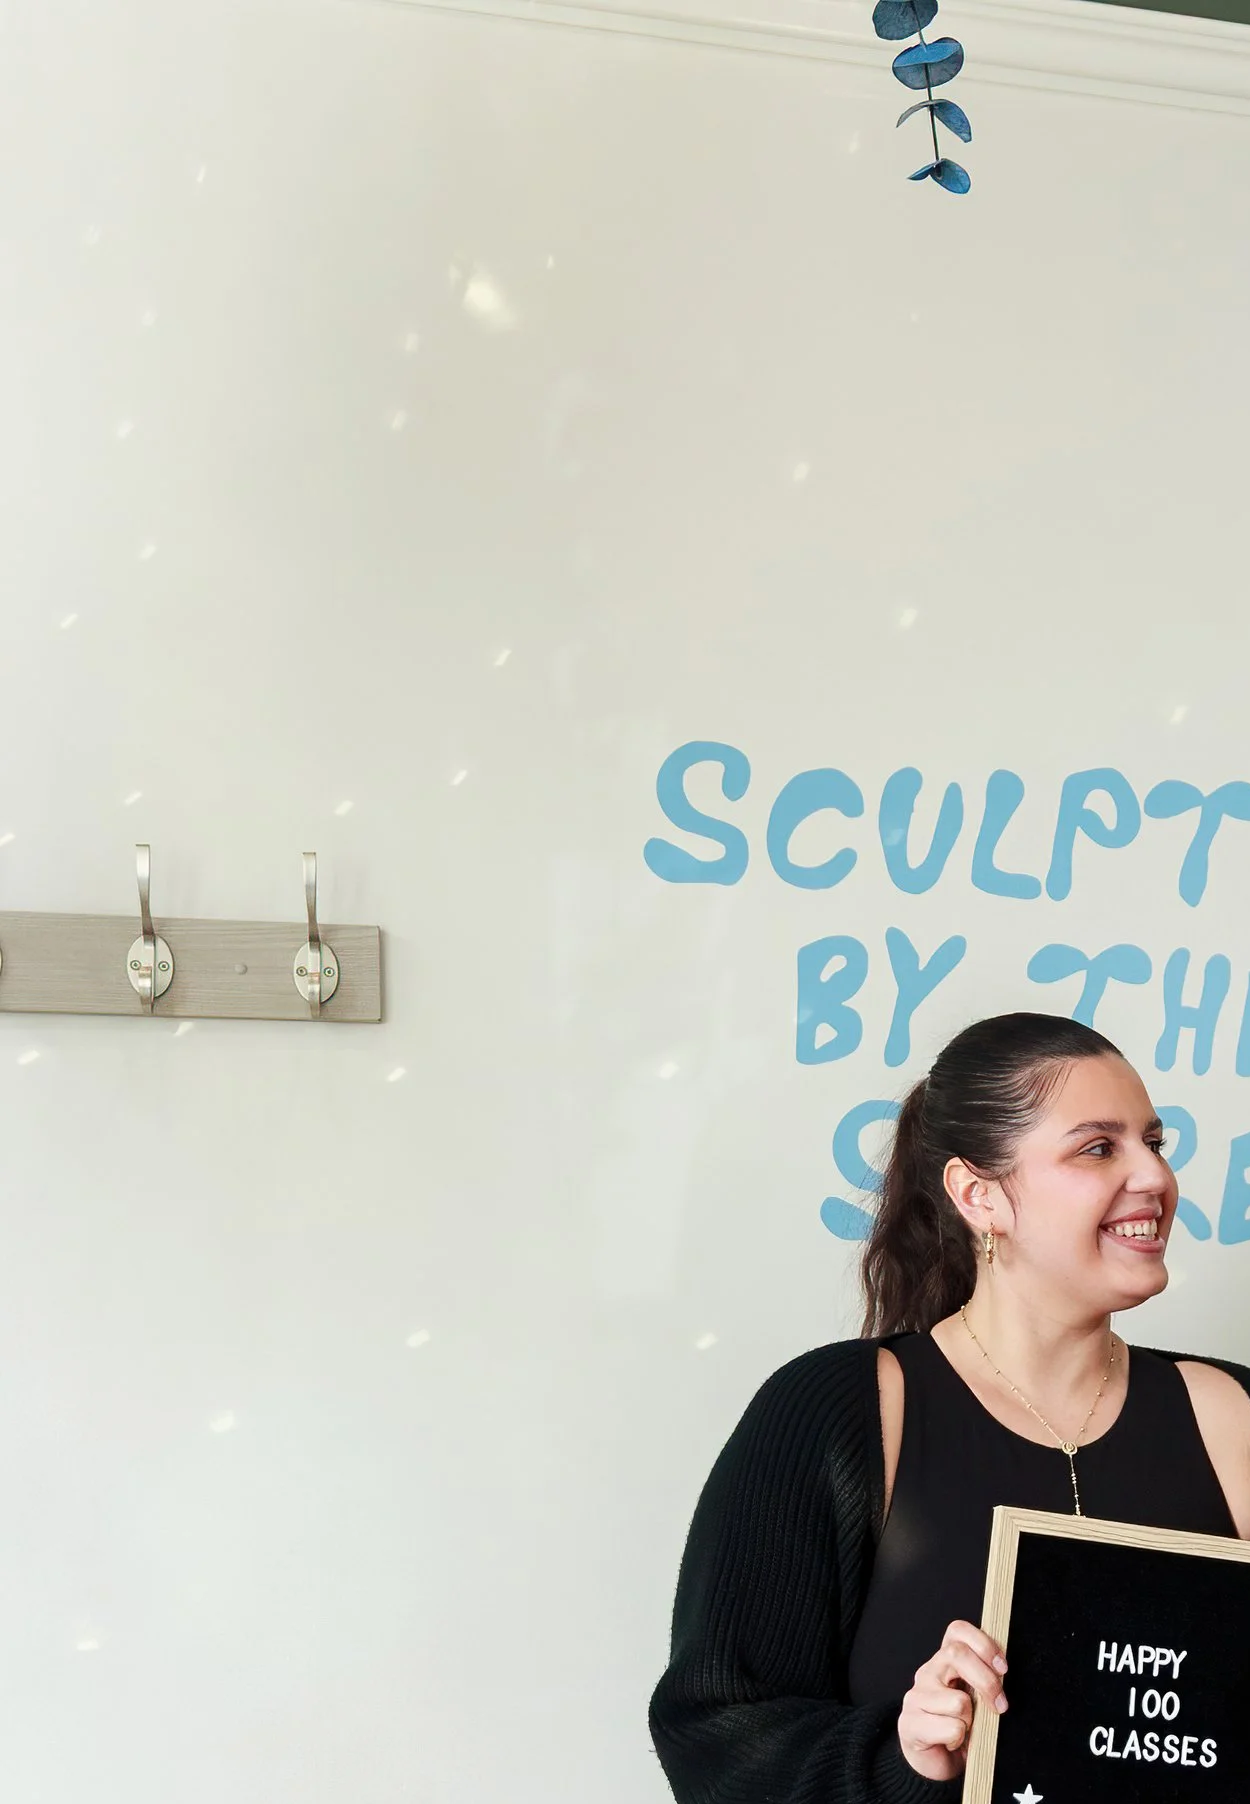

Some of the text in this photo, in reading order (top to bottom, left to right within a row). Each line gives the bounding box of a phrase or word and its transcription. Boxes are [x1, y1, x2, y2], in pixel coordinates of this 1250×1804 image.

[796, 927, 966, 1067] BY
[1098, 1640, 1188, 1680] HAPPY
[1129, 1687, 1181, 1721] 100
[1090, 1726, 1219, 1769] CLASSES
